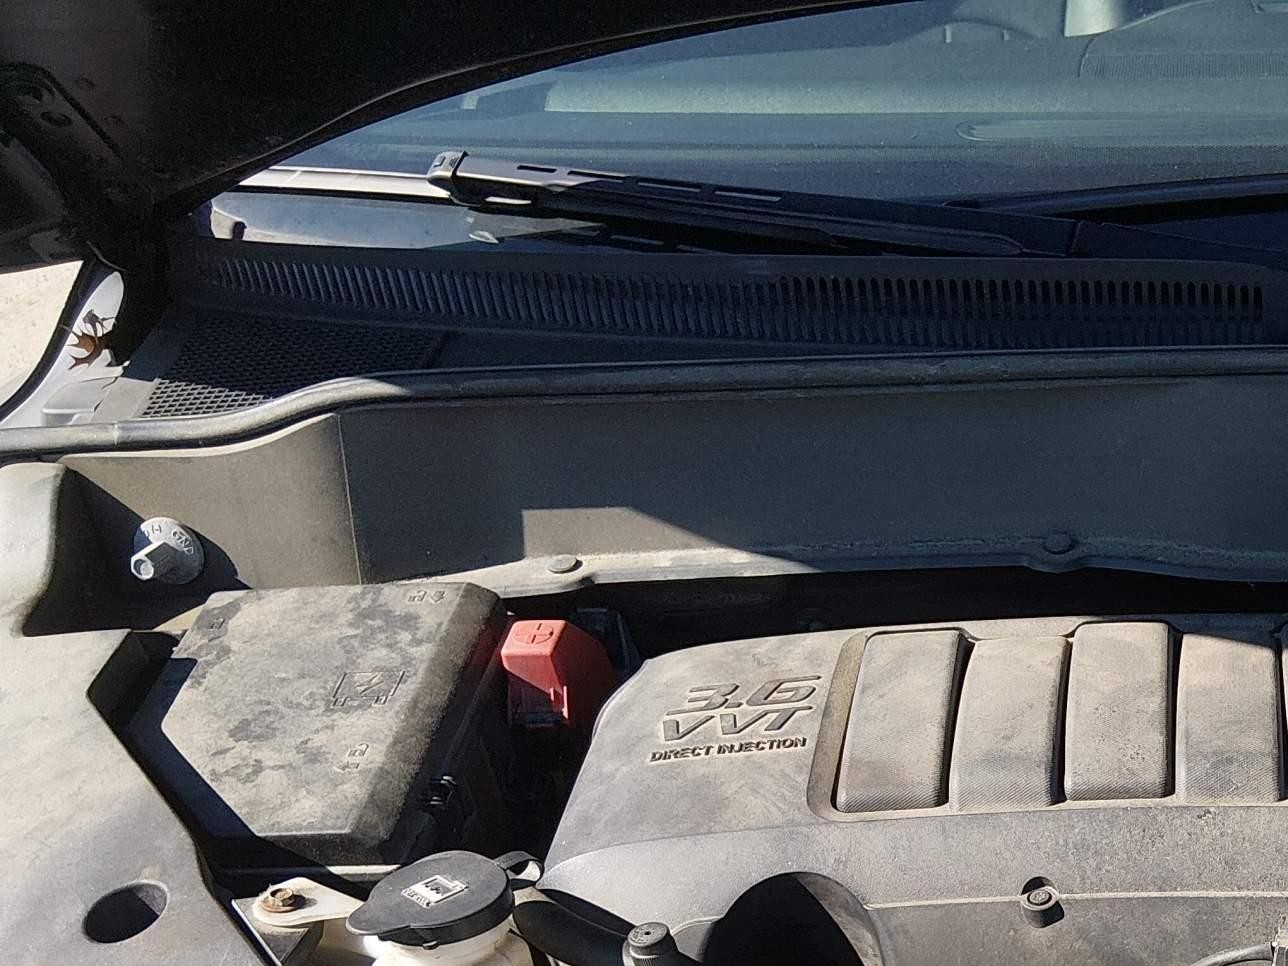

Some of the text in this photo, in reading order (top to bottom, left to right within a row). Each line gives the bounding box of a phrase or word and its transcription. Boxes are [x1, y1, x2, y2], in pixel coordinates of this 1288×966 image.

[665, 675, 822, 716] 3.6
[663, 706, 813, 742] VVT
[650, 736, 808, 762] DIRECT INJECTION
